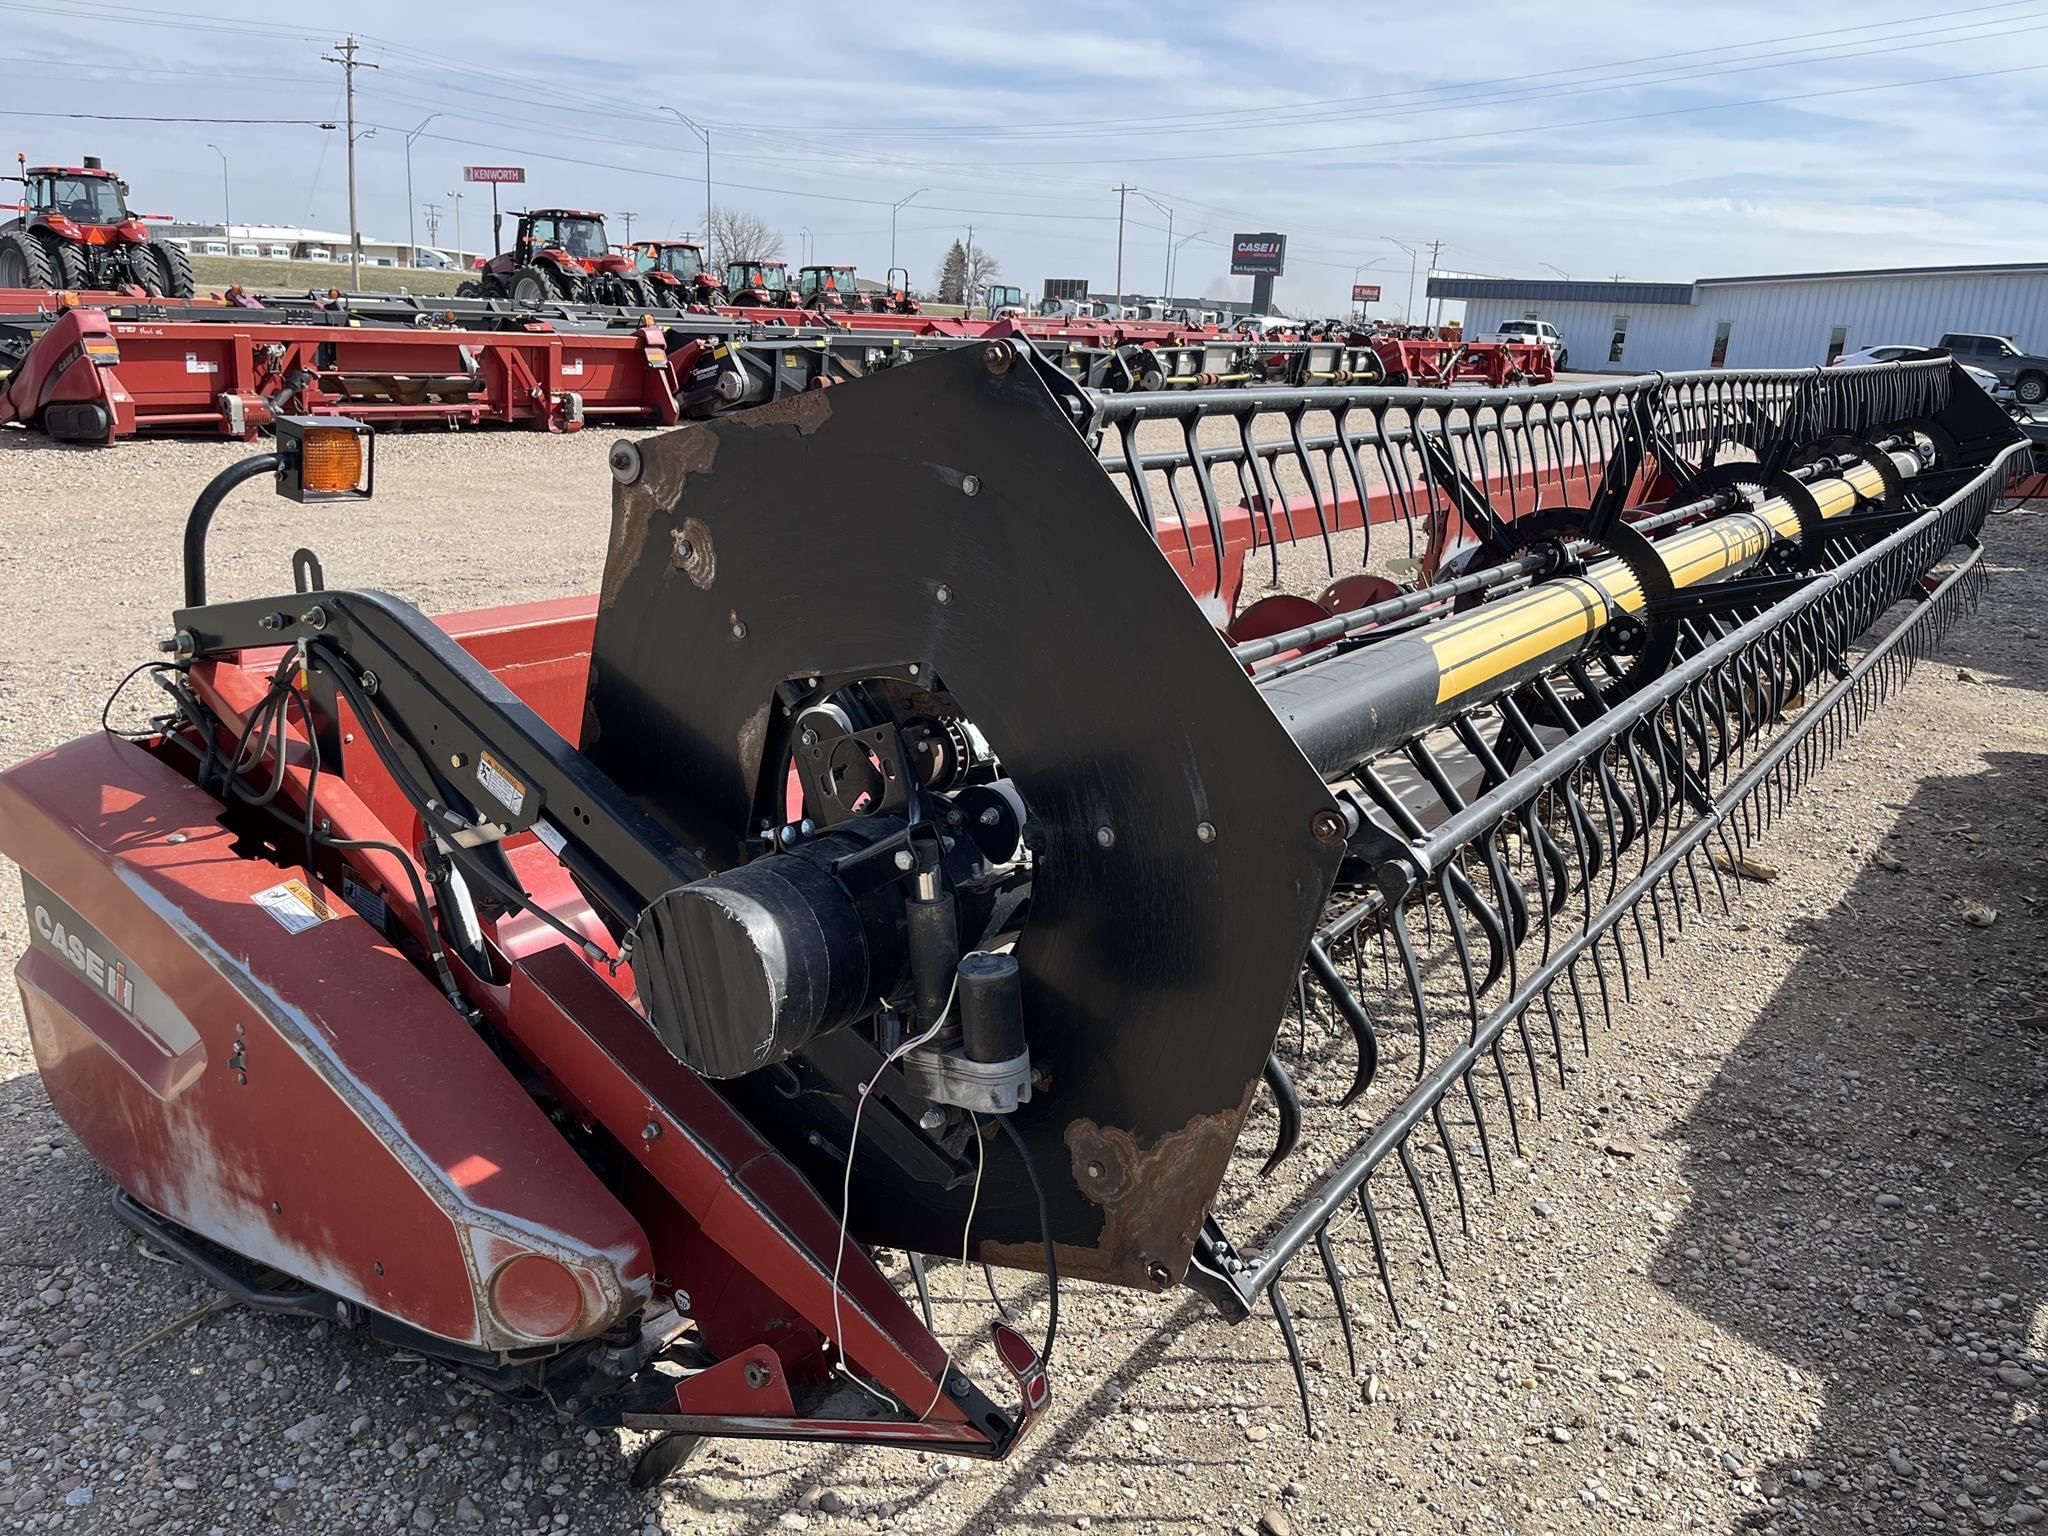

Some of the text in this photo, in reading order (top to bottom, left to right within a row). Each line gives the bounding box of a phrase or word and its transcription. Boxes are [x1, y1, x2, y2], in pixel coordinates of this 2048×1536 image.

[473, 168, 519, 181] KENWORTH
[1237, 242, 1269, 252] CASE
[298, 890, 329, 917] WARNING
[34, 905, 105, 988] CASE
